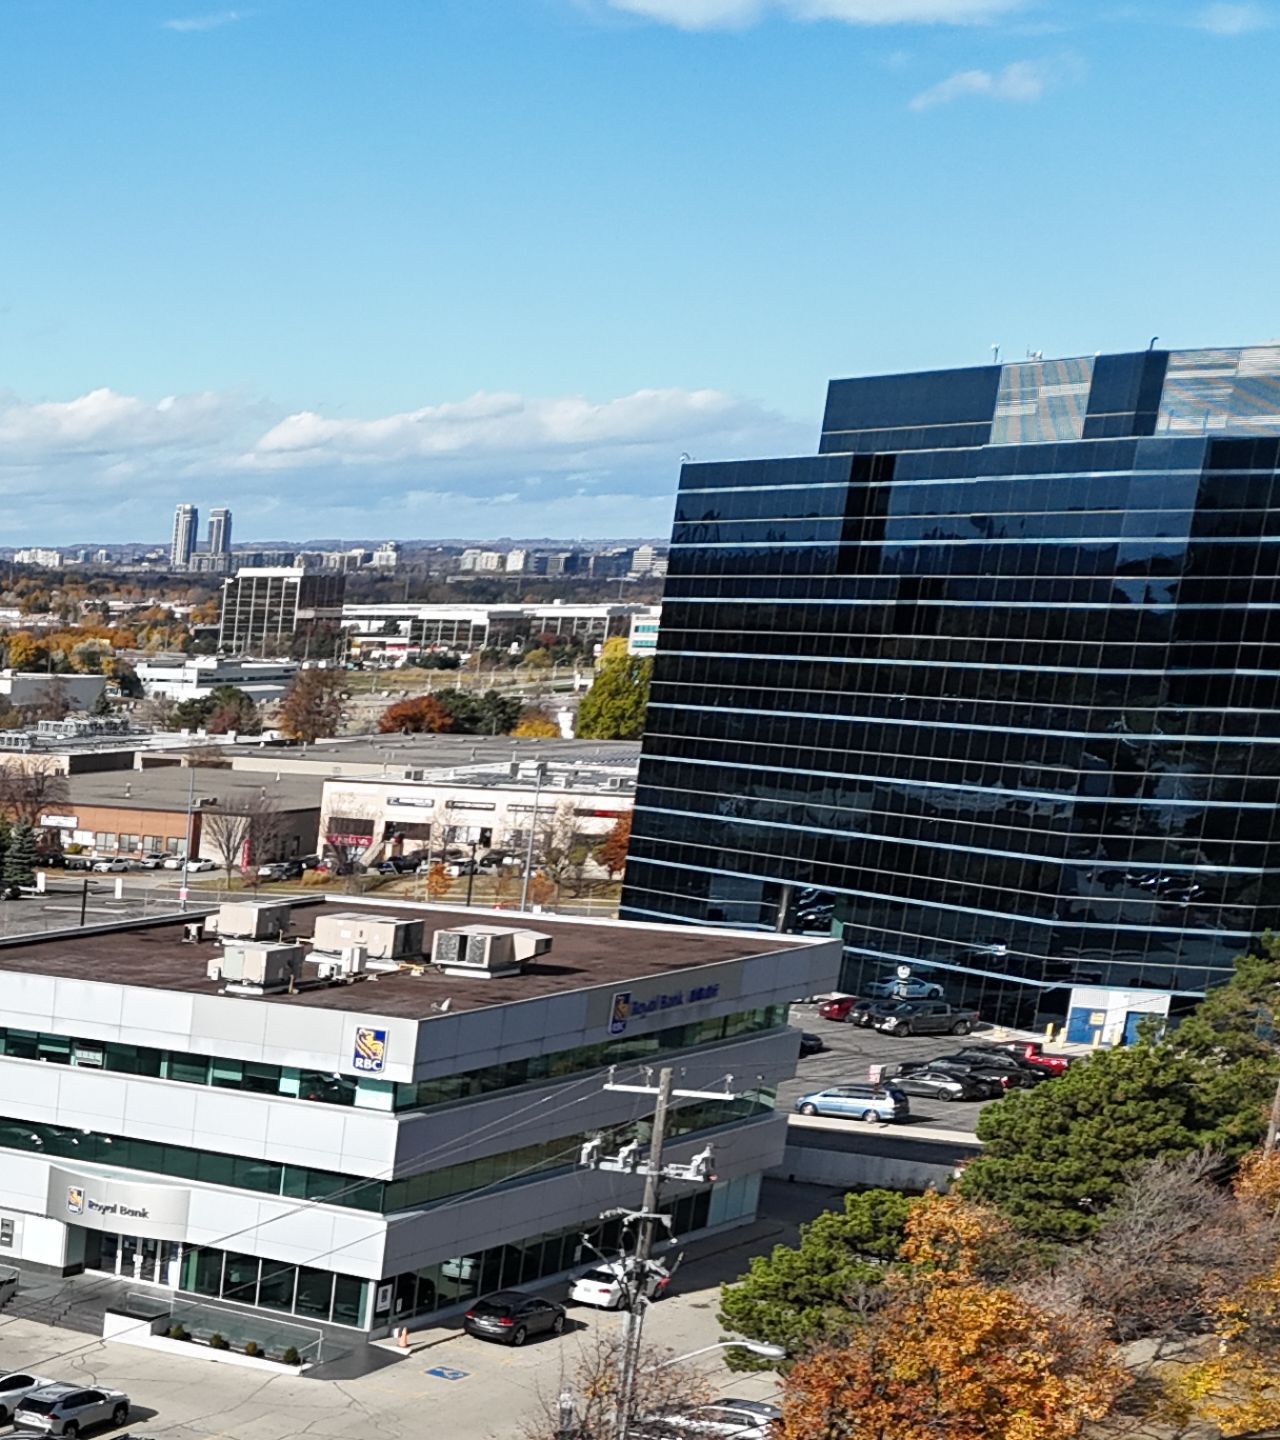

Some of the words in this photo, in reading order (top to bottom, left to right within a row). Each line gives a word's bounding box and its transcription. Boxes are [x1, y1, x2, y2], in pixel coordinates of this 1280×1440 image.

[355, 1057, 382, 1070] RBC
[88, 1199, 117, 1215] Royal
[119, 1205, 149, 1219] Bank
